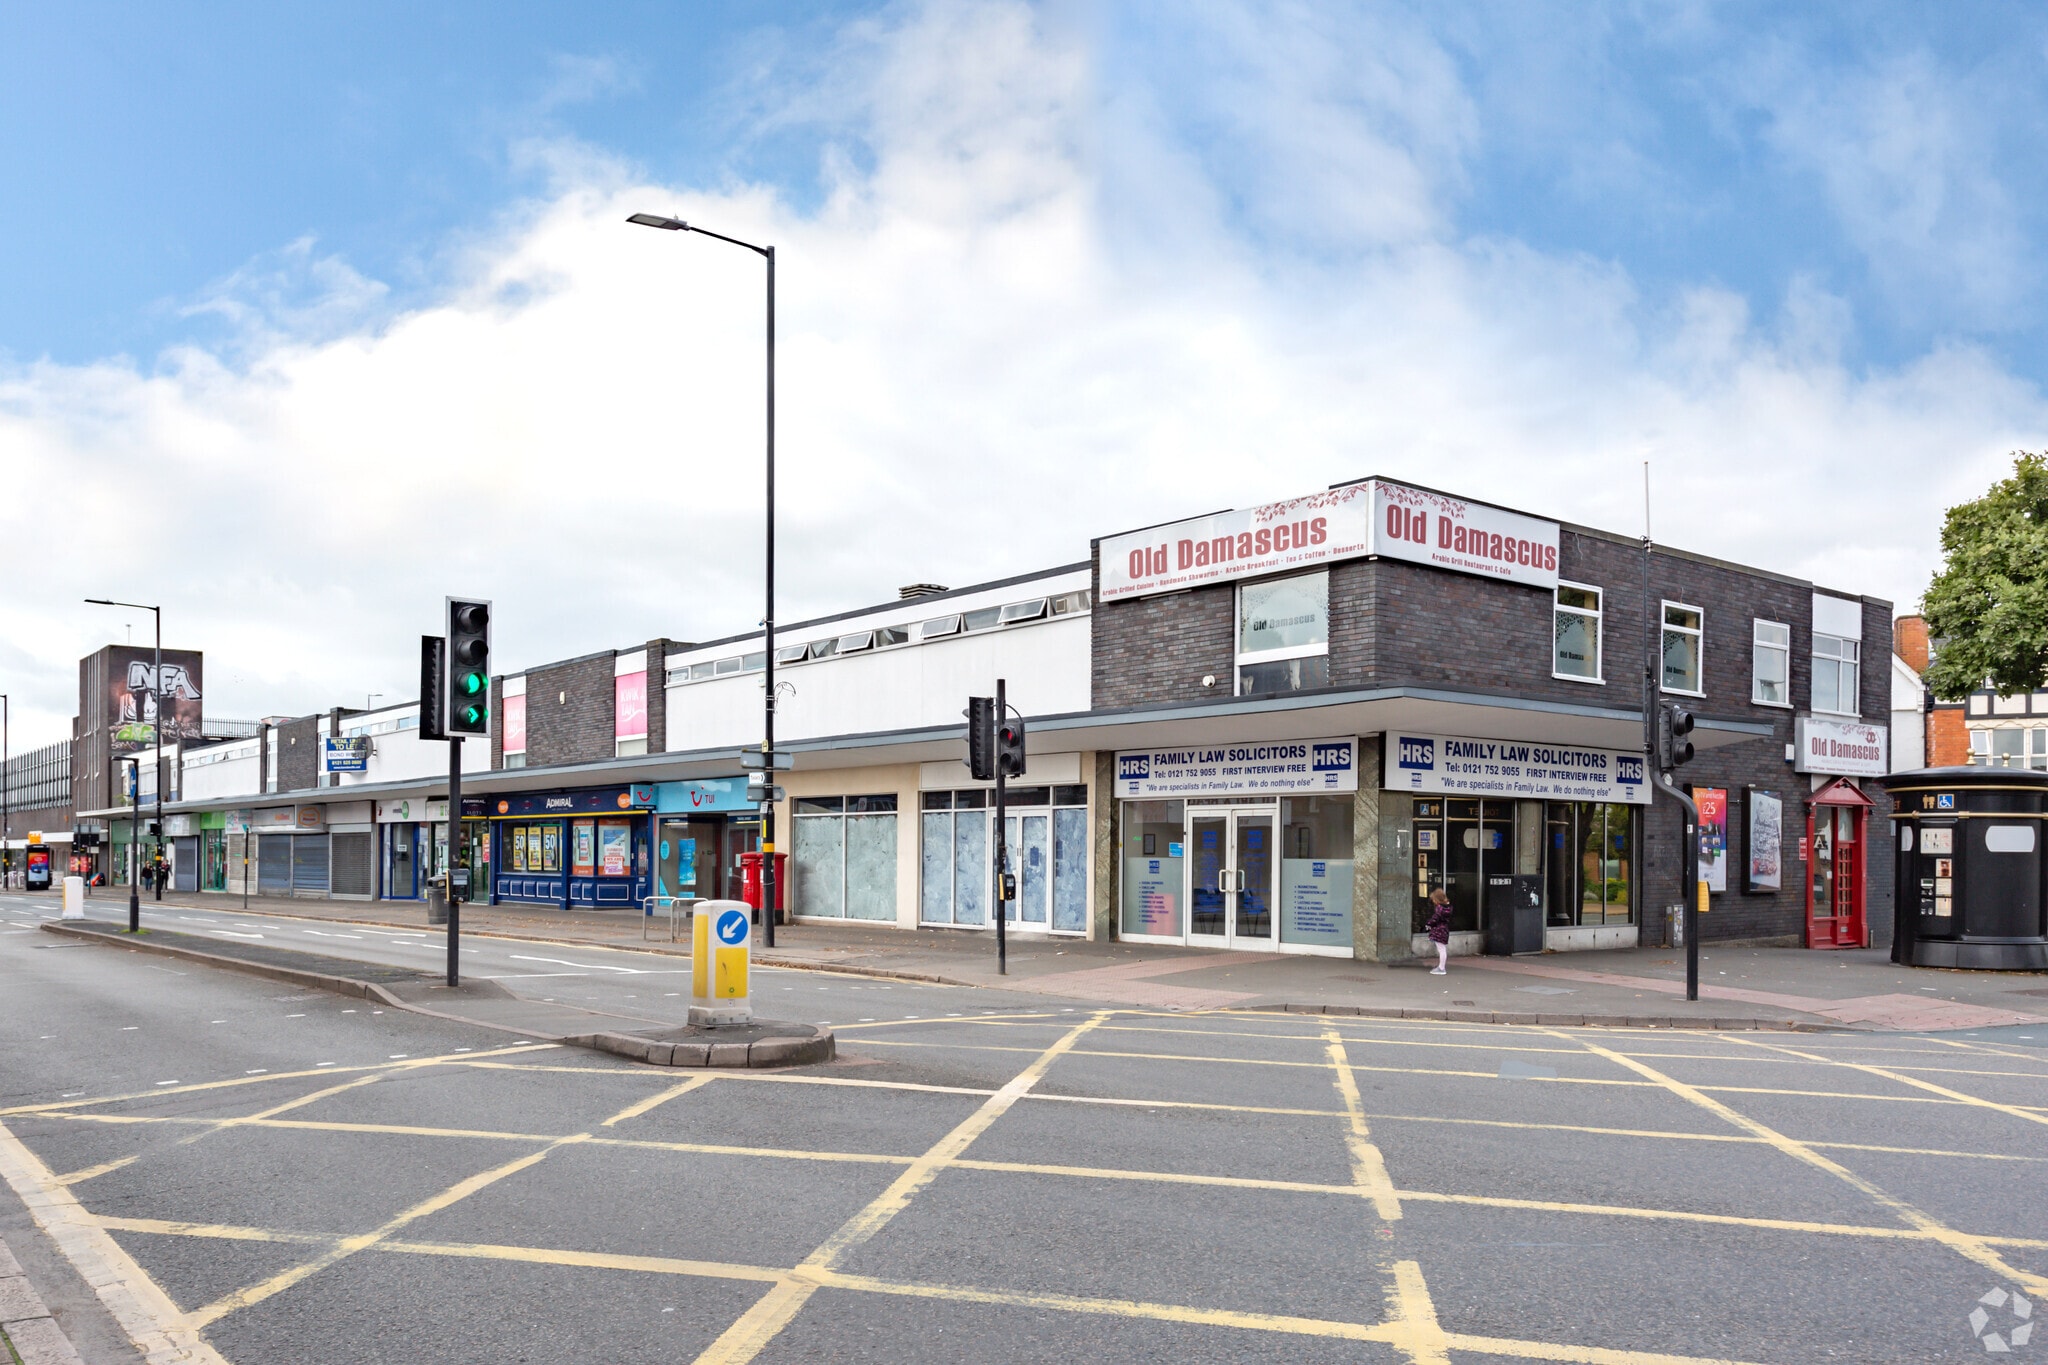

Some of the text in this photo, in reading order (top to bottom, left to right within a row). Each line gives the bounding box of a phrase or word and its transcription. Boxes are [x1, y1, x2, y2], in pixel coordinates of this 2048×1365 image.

[1386, 504, 1556, 572] Old Damascus
[1129, 517, 1327, 579] Old Damascus
[1225, 564, 1246, 574] Arabic
[1247, 558, 1280, 570] Breakfast
[1286, 555, 1297, 563] Tea
[1304, 550, 1326, 560] Coffee
[1333, 543, 1365, 554] Desserts
[1432, 552, 1450, 564] Arabic
[1452, 558, 1463, 566] Grill
[1464, 560, 1494, 572] Restaurant
[1500, 566, 1512, 576] Cafe
[1253, 614, 1316, 632] Old Damascus
[128, 662, 202, 699] NFA
[1154, 745, 1306, 766] FAMILY LAW SOLICITORS
[1313, 748, 1350, 766] HRS
[1400, 744, 1433, 764] HRS
[1445, 740, 1607, 768] FAMILY LAW SOLICITORS
[1812, 736, 1880, 760] Old Damascus
[1120, 760, 1149, 775] HRS
[1154, 764, 1306, 778] Tel: 0121 752 9055 FIRST INTERVIEW FREE
[1445, 762, 1607, 782] Tel: 0121 752 9055 FIRST INTERVIEW FREE
[1617, 762, 1642, 780] HRS
[1170, 782, 1200, 792] specialists
[1208, 782, 1228, 790] Family
[1230, 781, 1244, 789] Law.
[1248, 780, 1258, 788] We
[1260, 780, 1268, 788] do
[1270, 778, 1296, 788] nothing
[1456, 780, 1468, 788] are
[1470, 780, 1504, 790] specialists
[1506, 782, 1512, 790] in
[1514, 782, 1535, 794] Family
[1536, 783, 1550, 793] Law.
[1553, 784, 1562, 794] We
[1564, 785, 1572, 794] do
[1573, 786, 1594, 798] nothing
[546, 796, 574, 808] ADMIRAL
[704, 794, 714, 804] TUI
[1702, 802, 1716, 814] £25
[515, 835, 524, 850] 50
[546, 834, 554, 850] 50
